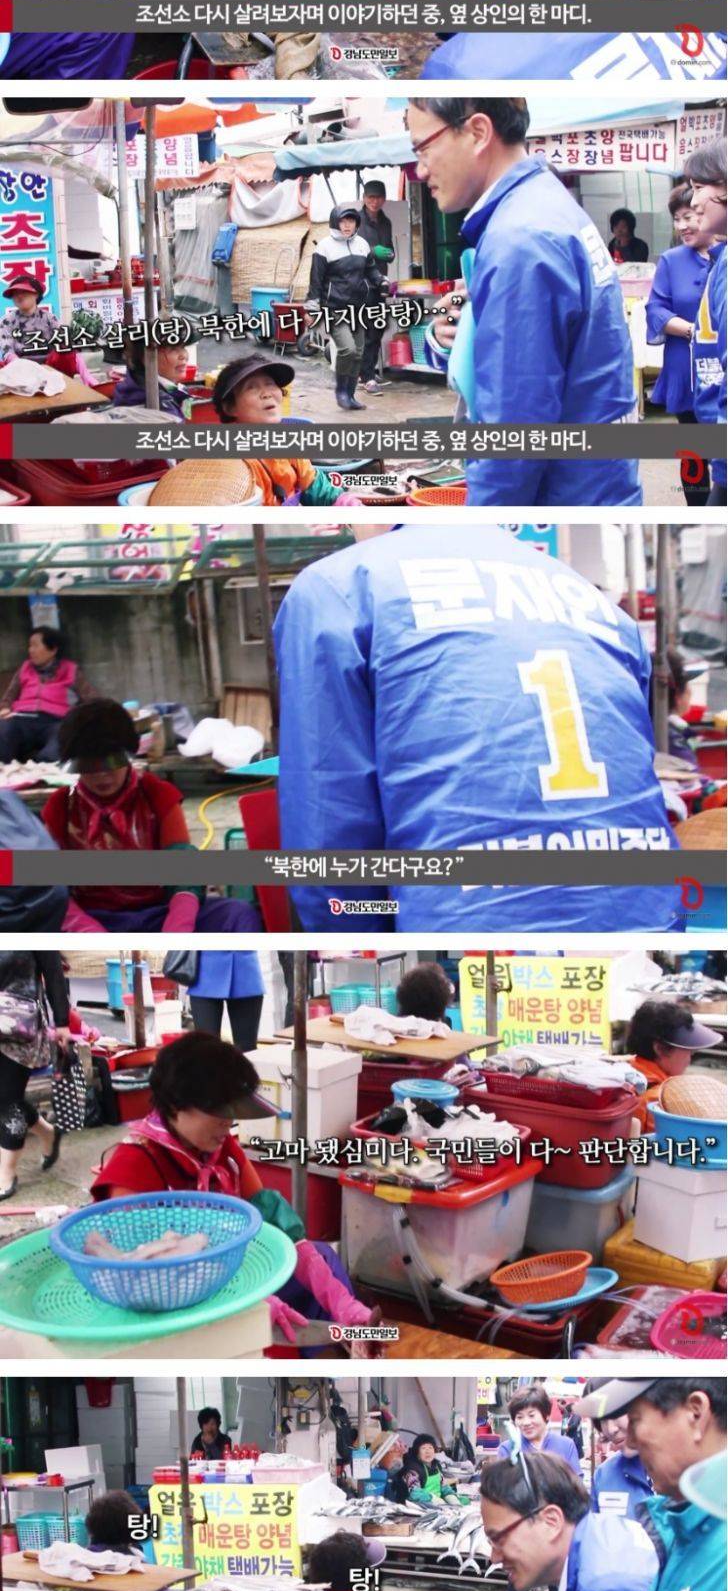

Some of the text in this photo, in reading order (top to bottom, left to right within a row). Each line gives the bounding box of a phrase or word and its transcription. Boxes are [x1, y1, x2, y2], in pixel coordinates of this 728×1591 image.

[619, 142, 668, 163] 팝니다
[399, 557, 623, 647] 문재인
[517, 649, 610, 801] 1
[560, 965, 606, 992] 포장
[507, 997, 561, 1025] 매운탕
[566, 998, 603, 1025] 양념
[250, 1491, 294, 1517] 포장
[198, 1523, 252, 1550] 매운탕
[256, 1523, 293, 1550] 양념
